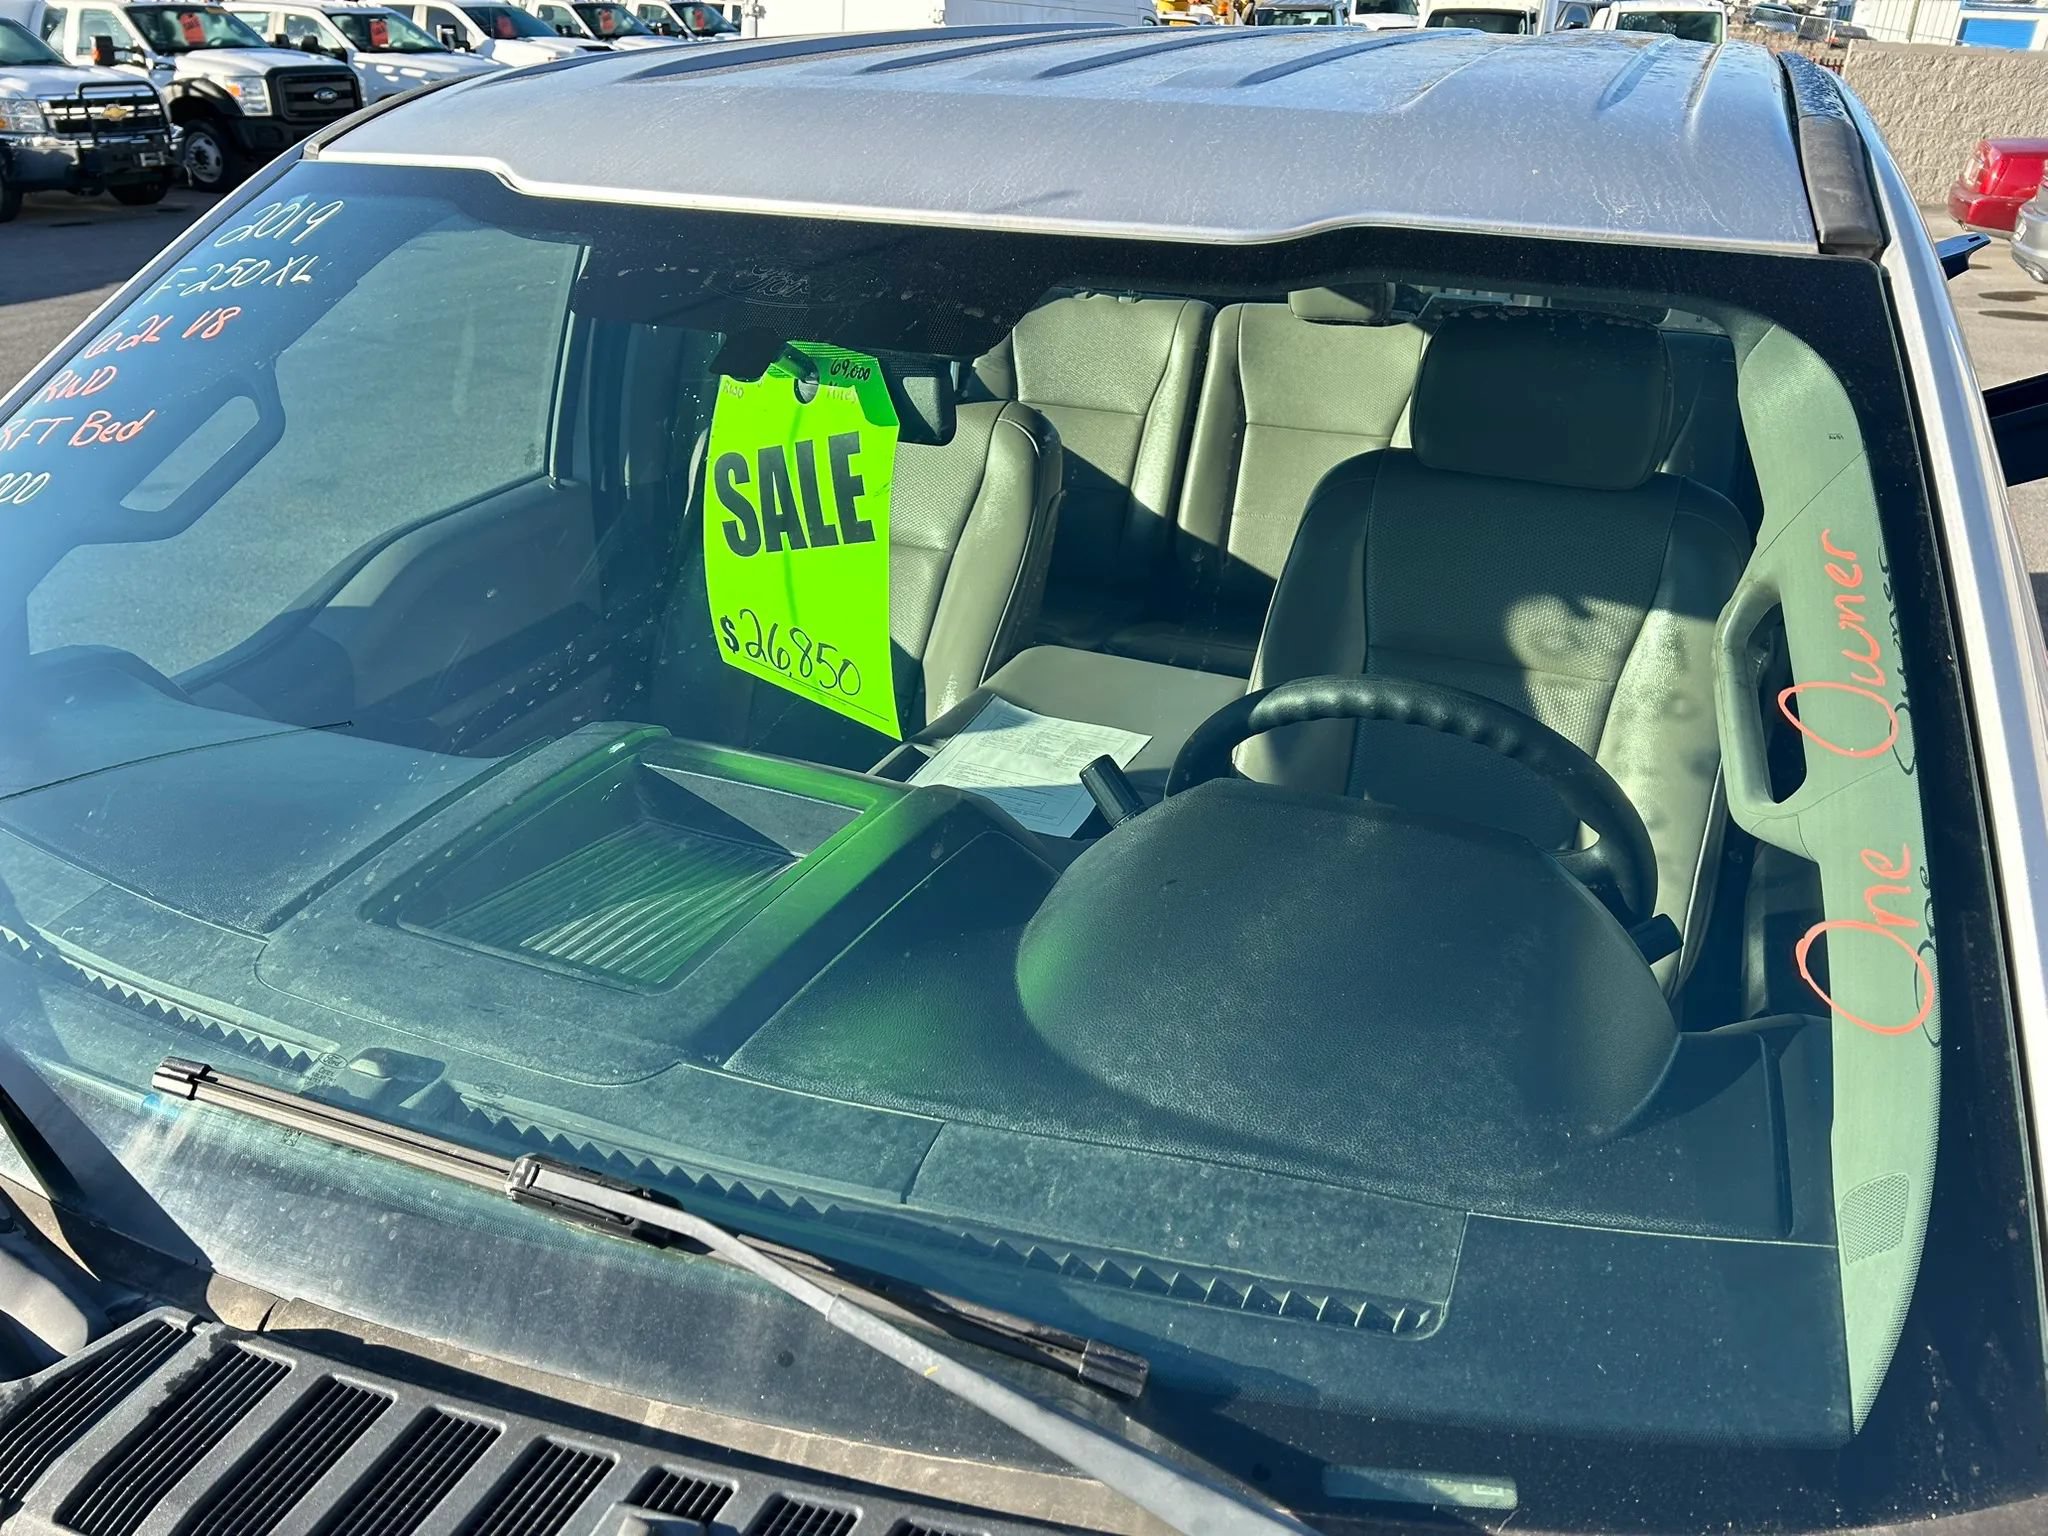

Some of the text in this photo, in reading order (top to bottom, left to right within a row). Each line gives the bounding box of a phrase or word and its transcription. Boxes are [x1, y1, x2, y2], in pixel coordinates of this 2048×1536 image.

[213, 200, 345, 248] 2019
[181, 306, 243, 340] V8
[35, 365, 118, 404] RWD
[830, 358, 871, 381] 69,000
[66, 409, 157, 447] Bed
[714, 431, 876, 558] SALE
[719, 608, 861, 696] $26,850
[1778, 527, 1935, 1037] One Owner
